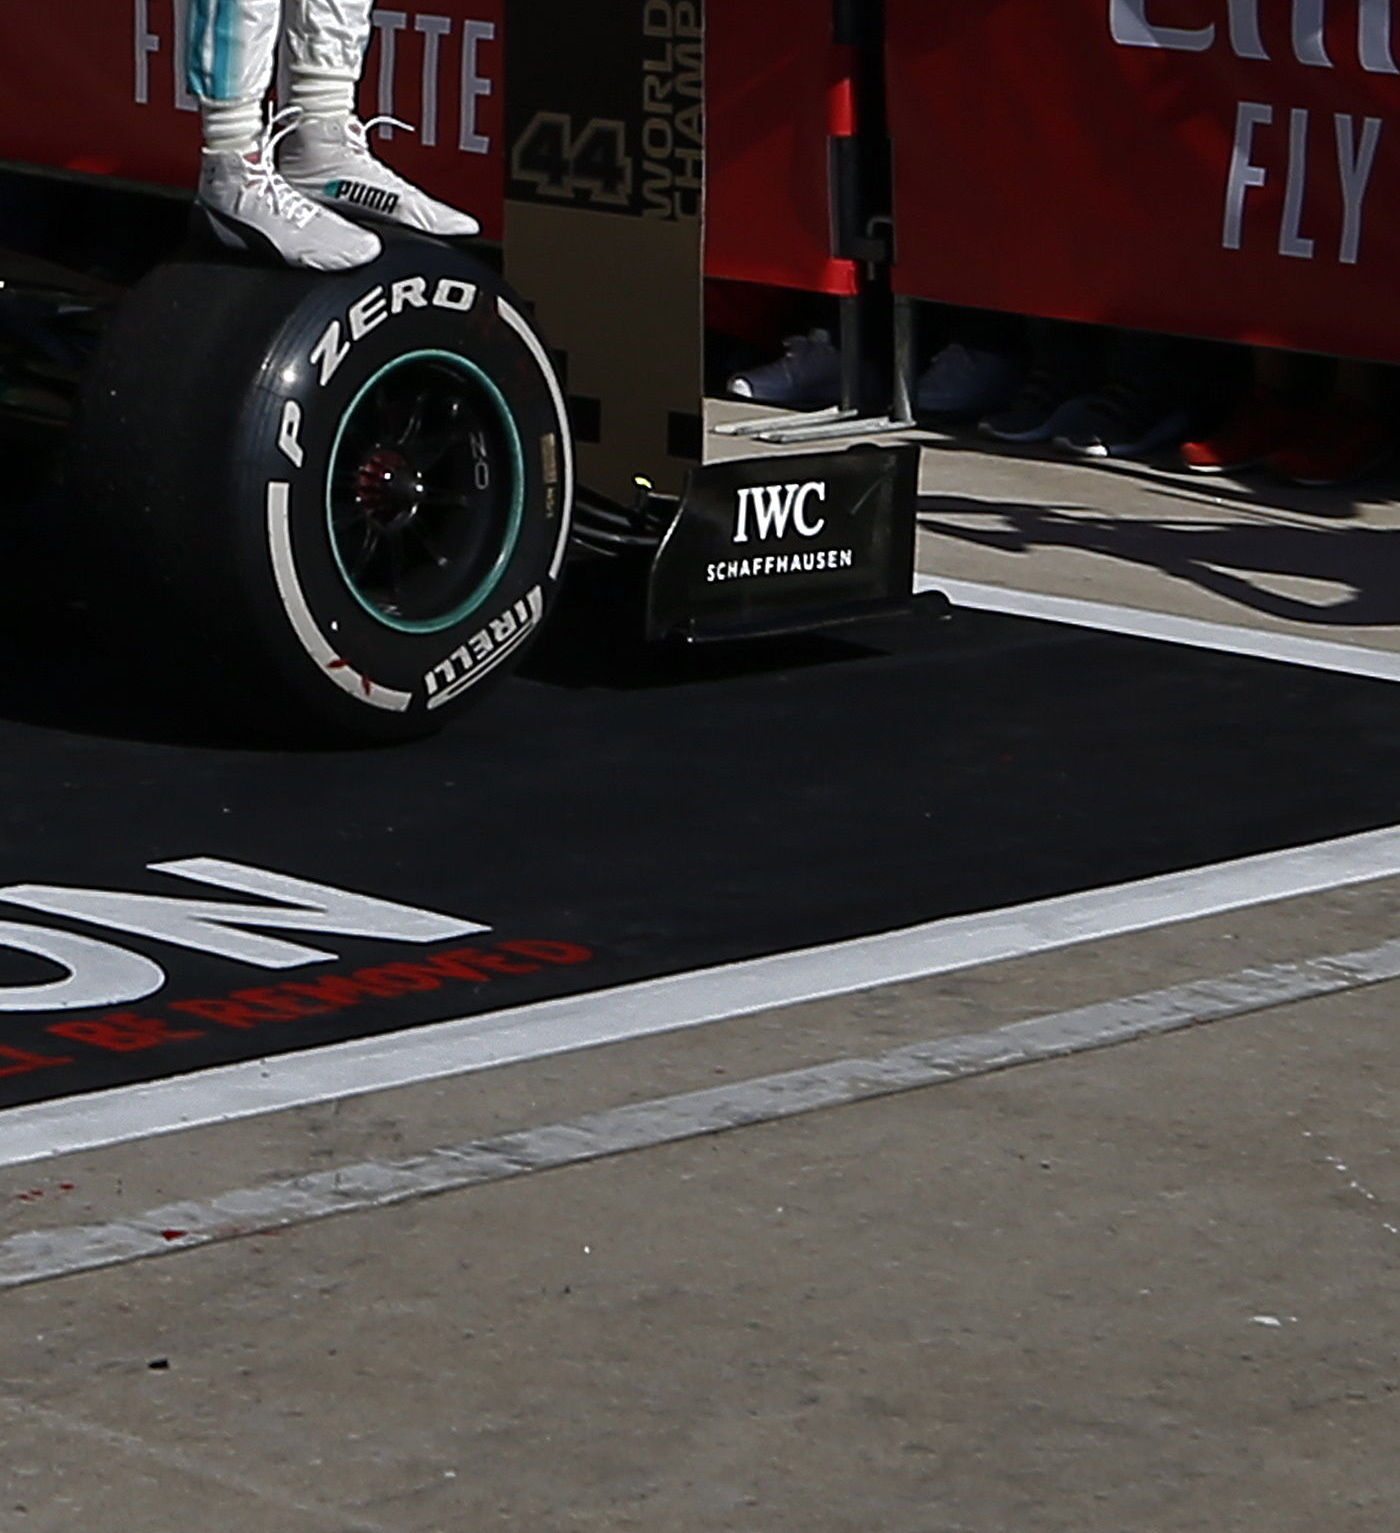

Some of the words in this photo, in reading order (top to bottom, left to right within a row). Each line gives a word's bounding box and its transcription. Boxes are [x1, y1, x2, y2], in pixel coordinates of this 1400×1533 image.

[333, 181, 400, 214] PUMA
[1221, 100, 1383, 265] FLY
[276, 399, 305, 468] P
[309, 274, 478, 387] ZERO
[705, 548, 854, 583] SCHAFFHAUSEN
[732, 480, 828, 544] IWC
[425, 584, 545, 711] PIRELLI
[45, 1011, 206, 1054] BE
[182, 938, 595, 1031] REMOVED
